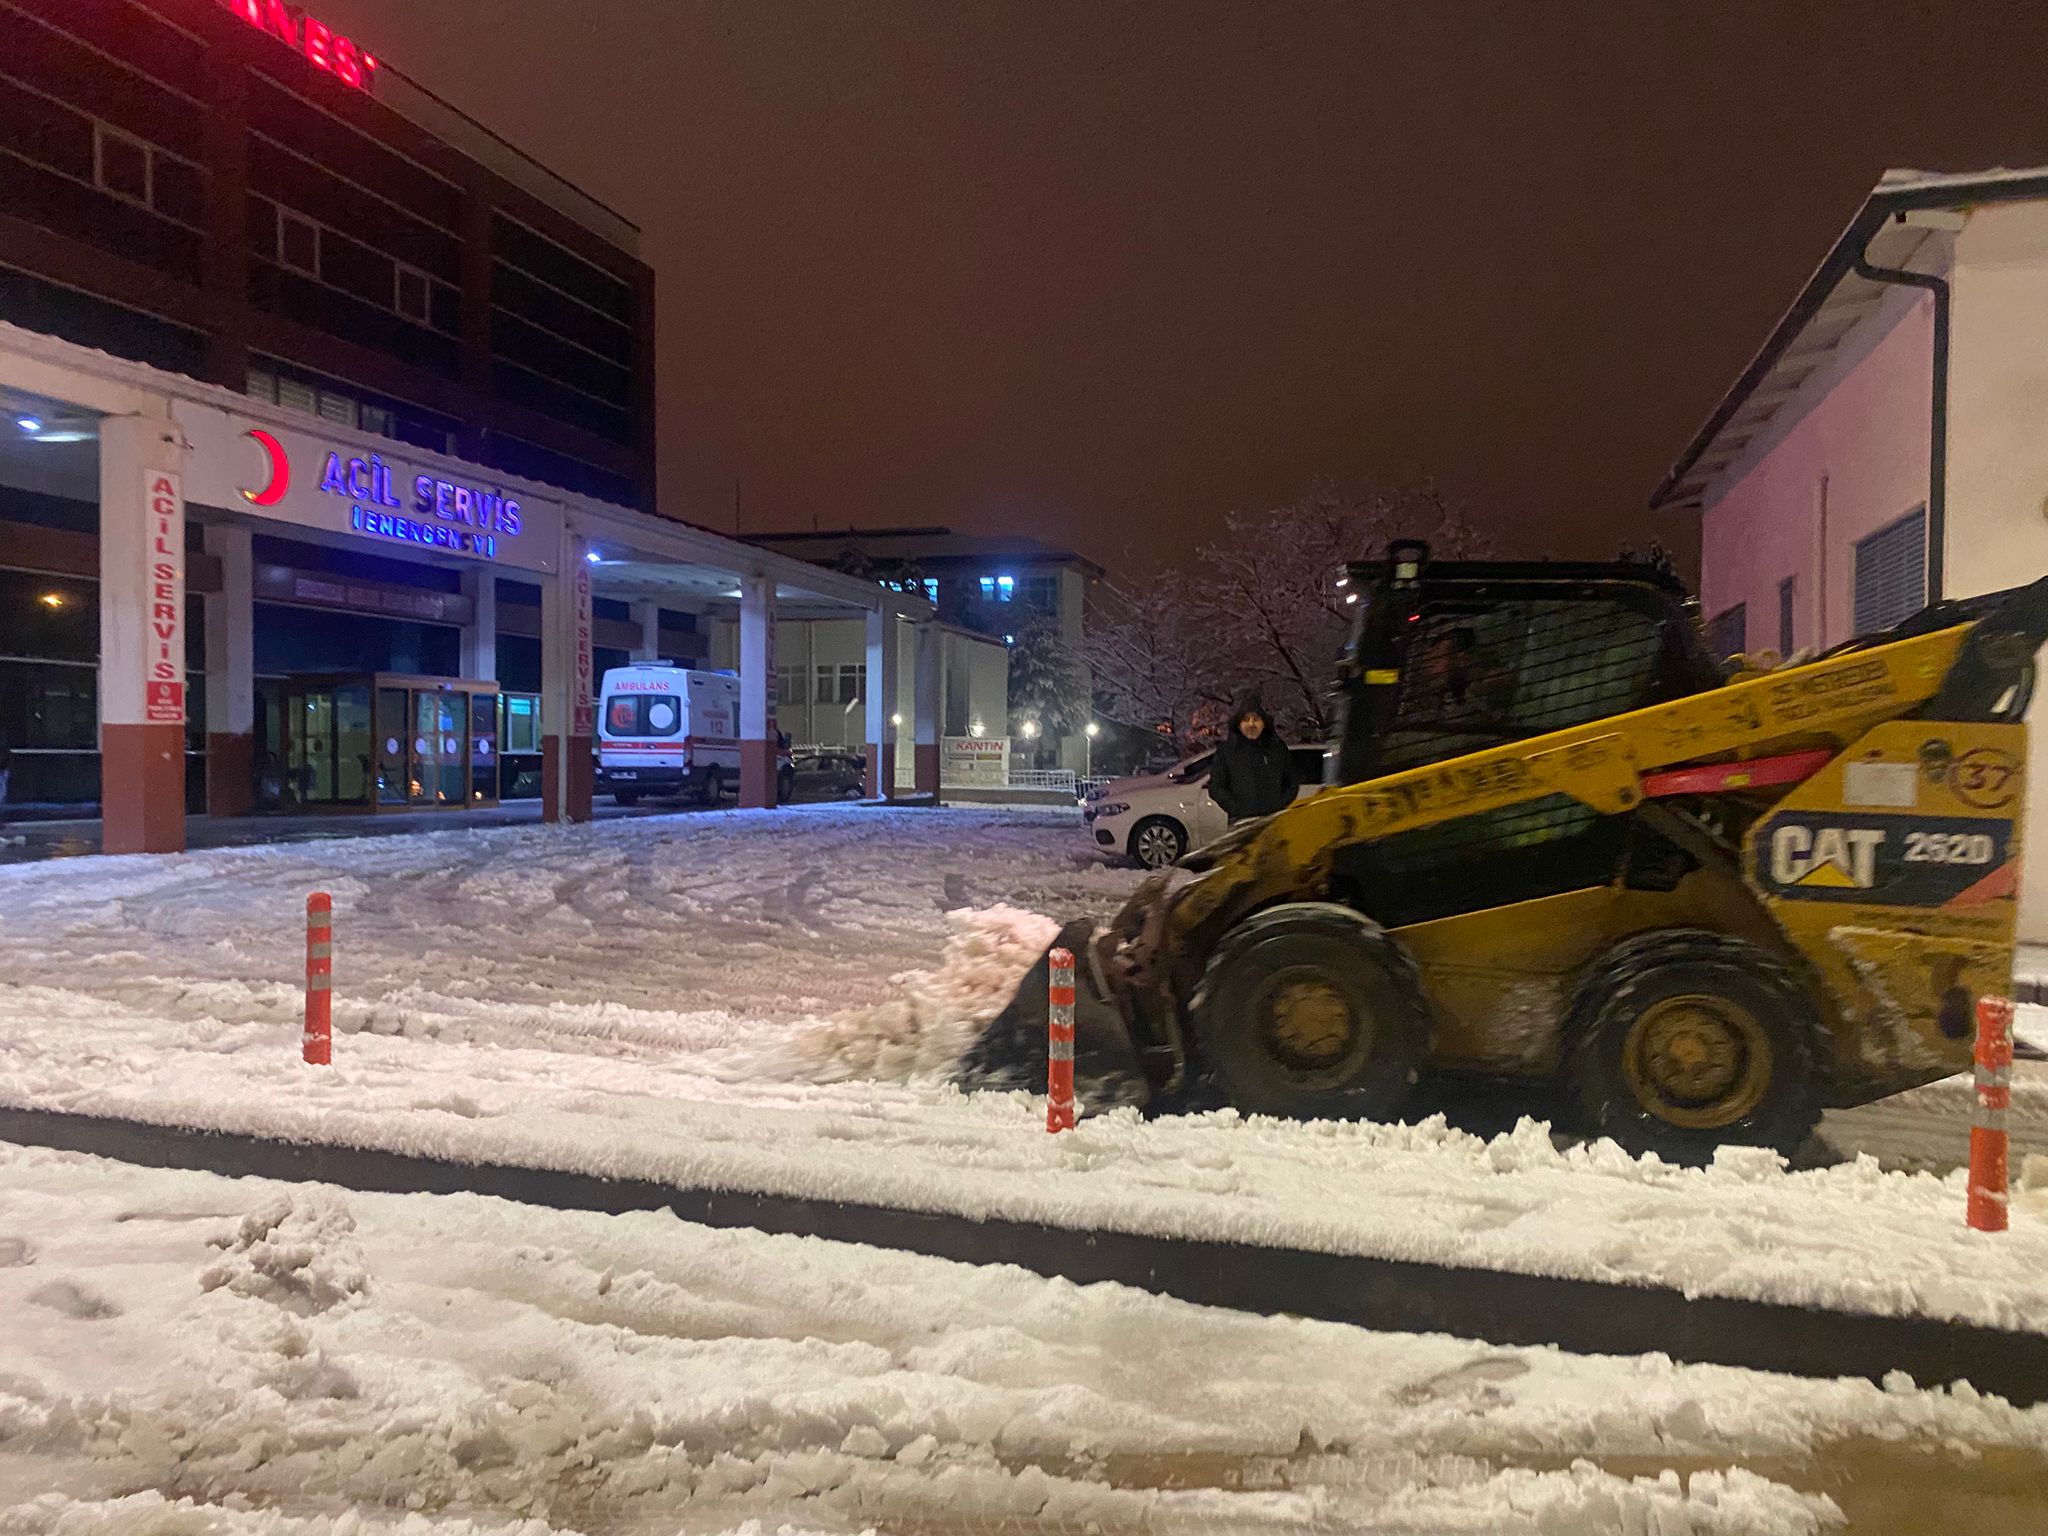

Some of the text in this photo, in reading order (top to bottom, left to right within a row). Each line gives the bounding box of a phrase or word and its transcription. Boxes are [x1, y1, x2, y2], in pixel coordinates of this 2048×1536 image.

[320, 451, 522, 536] ACİL SERVİS
[615, 681, 670, 691] AMBULANS
[1771, 825, 1886, 889] CAT
